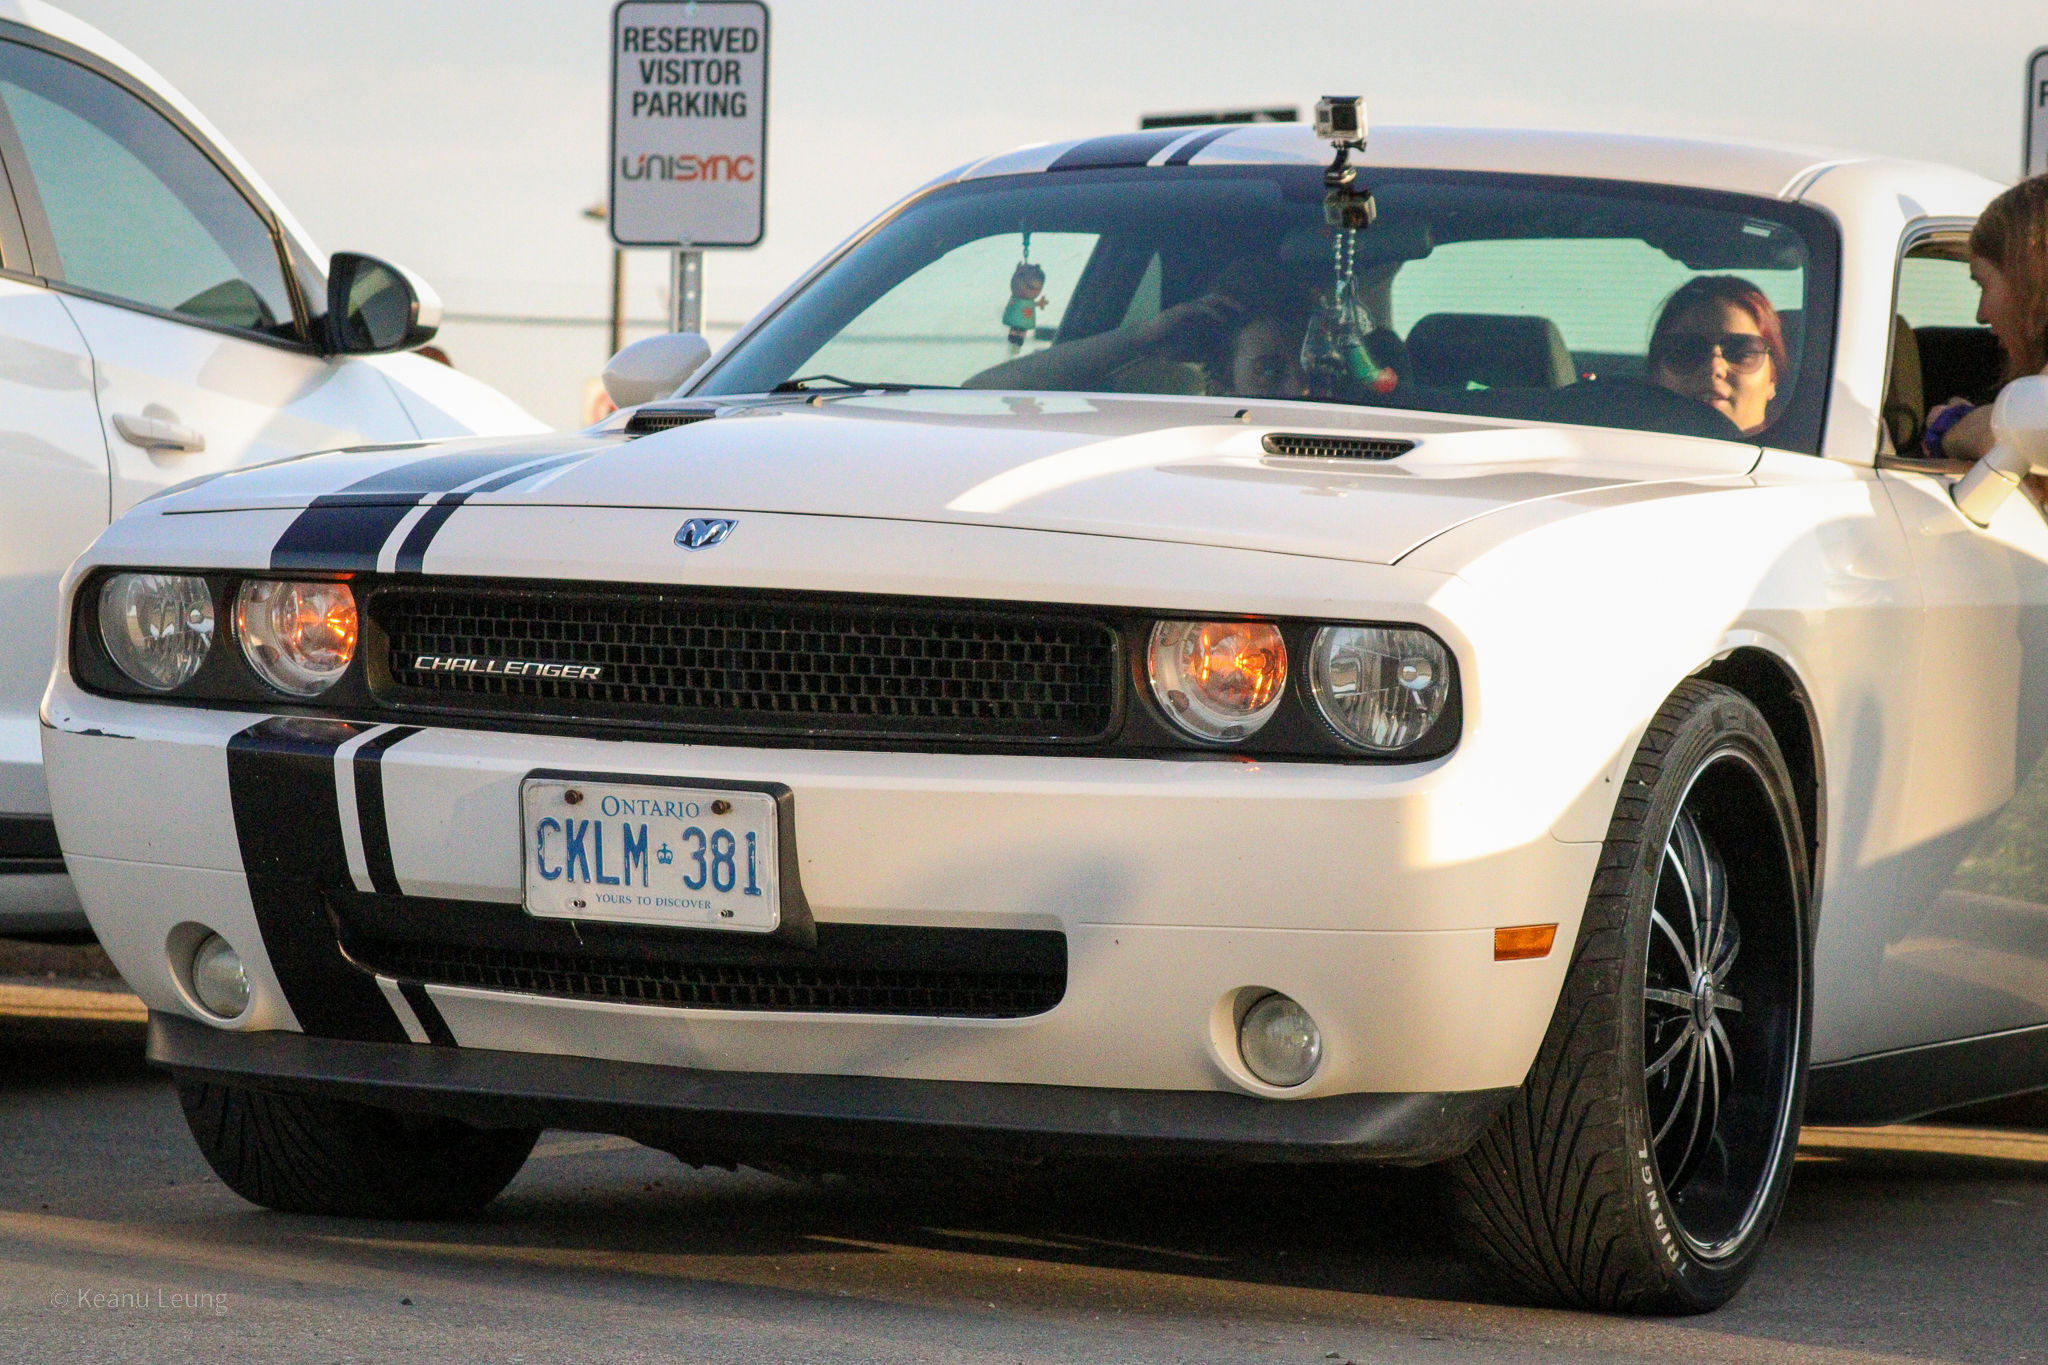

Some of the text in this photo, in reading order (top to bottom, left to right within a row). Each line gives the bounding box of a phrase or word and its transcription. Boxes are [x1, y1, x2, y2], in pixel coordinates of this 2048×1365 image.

[623, 26, 759, 53] RESERVED
[639, 59, 741, 85] VISITOR
[632, 91, 747, 118] PARKING
[414, 656, 601, 680] CHALLENGER
[537, 816, 762, 896] CKLM 381
[595, 893, 712, 909] YOURS TO DISCOVER
